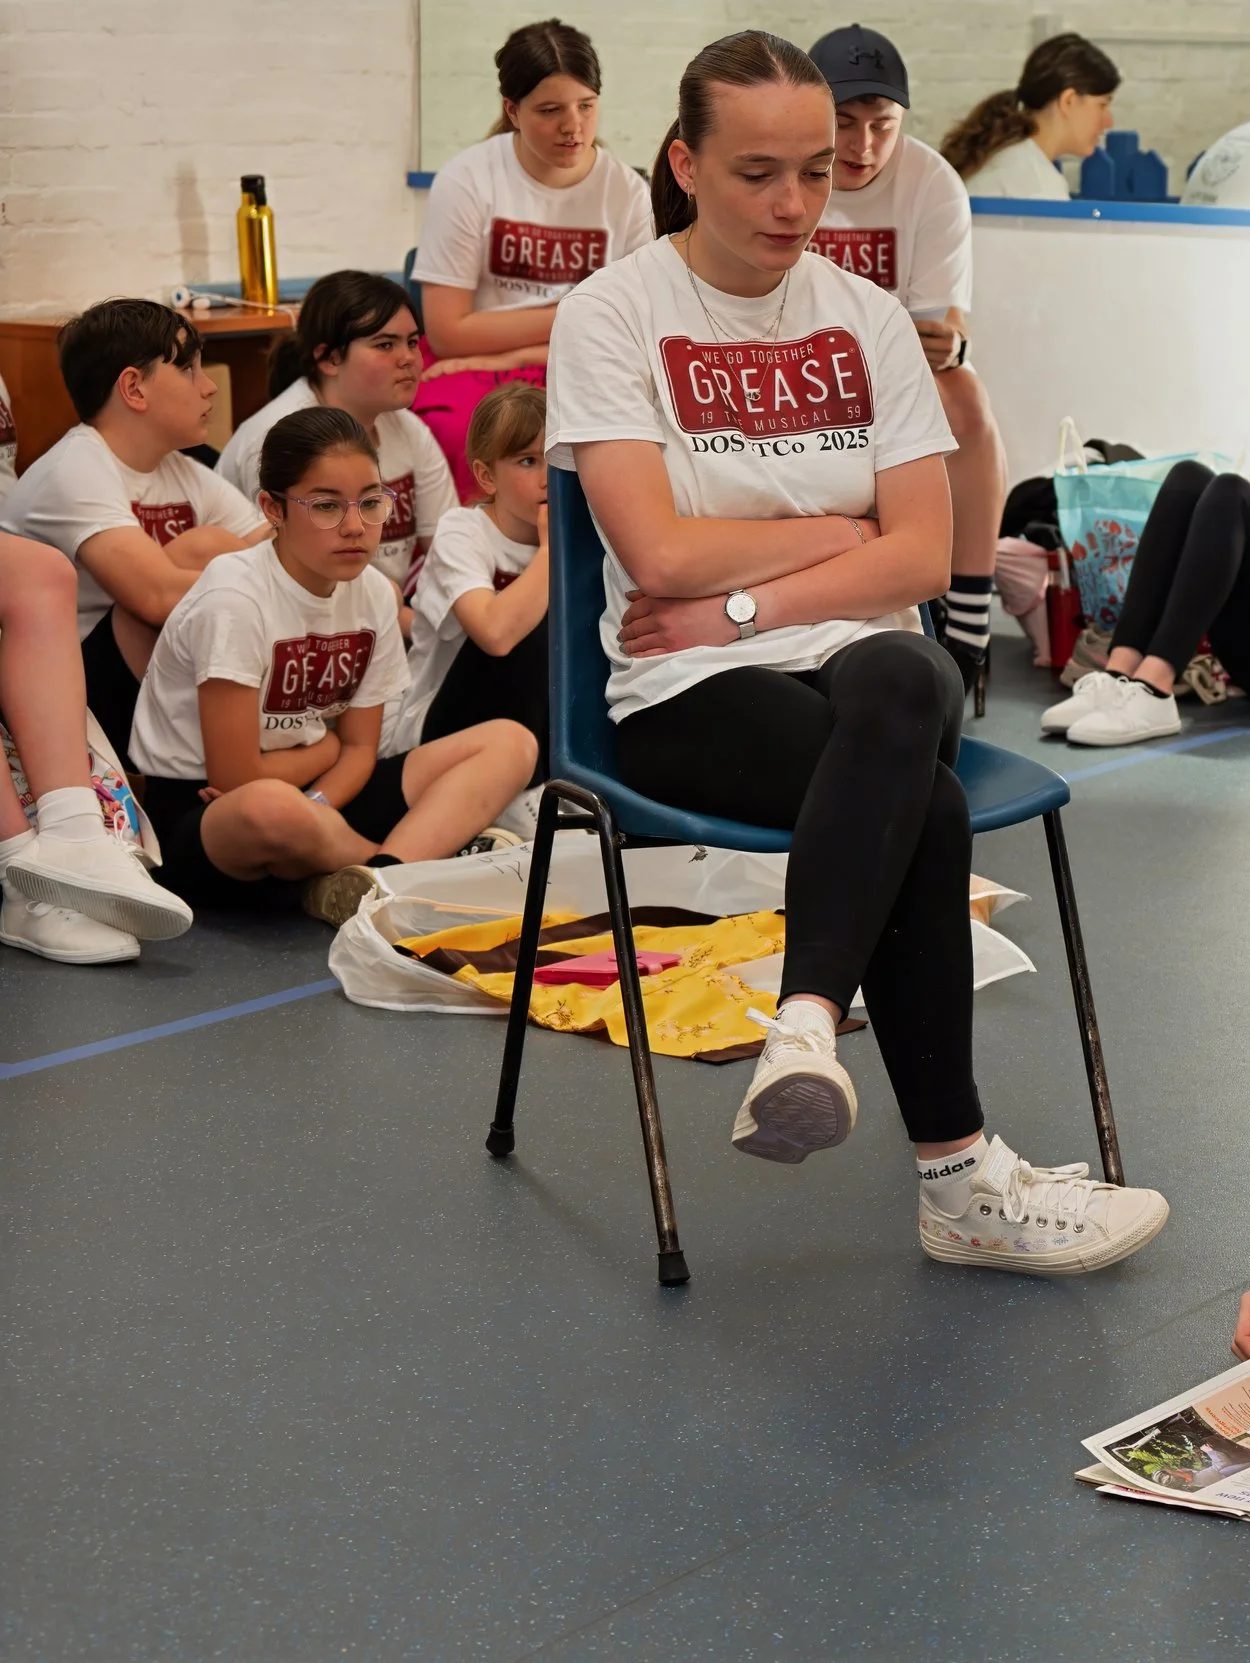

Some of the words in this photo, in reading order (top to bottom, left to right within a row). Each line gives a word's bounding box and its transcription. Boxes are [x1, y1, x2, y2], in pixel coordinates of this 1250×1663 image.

[501, 234, 600, 271] GREASE
[702, 351, 720, 364] WE
[727, 351, 743, 364] GO
[751, 343, 814, 364] TOGETHER
[689, 352, 857, 413] GREASE
[700, 411, 713, 424] 19
[755, 409, 831, 432] MUSICAL
[847, 405, 861, 418] 59
[691, 433, 805, 458] DOSTCo
[816, 429, 869, 451] 2025
